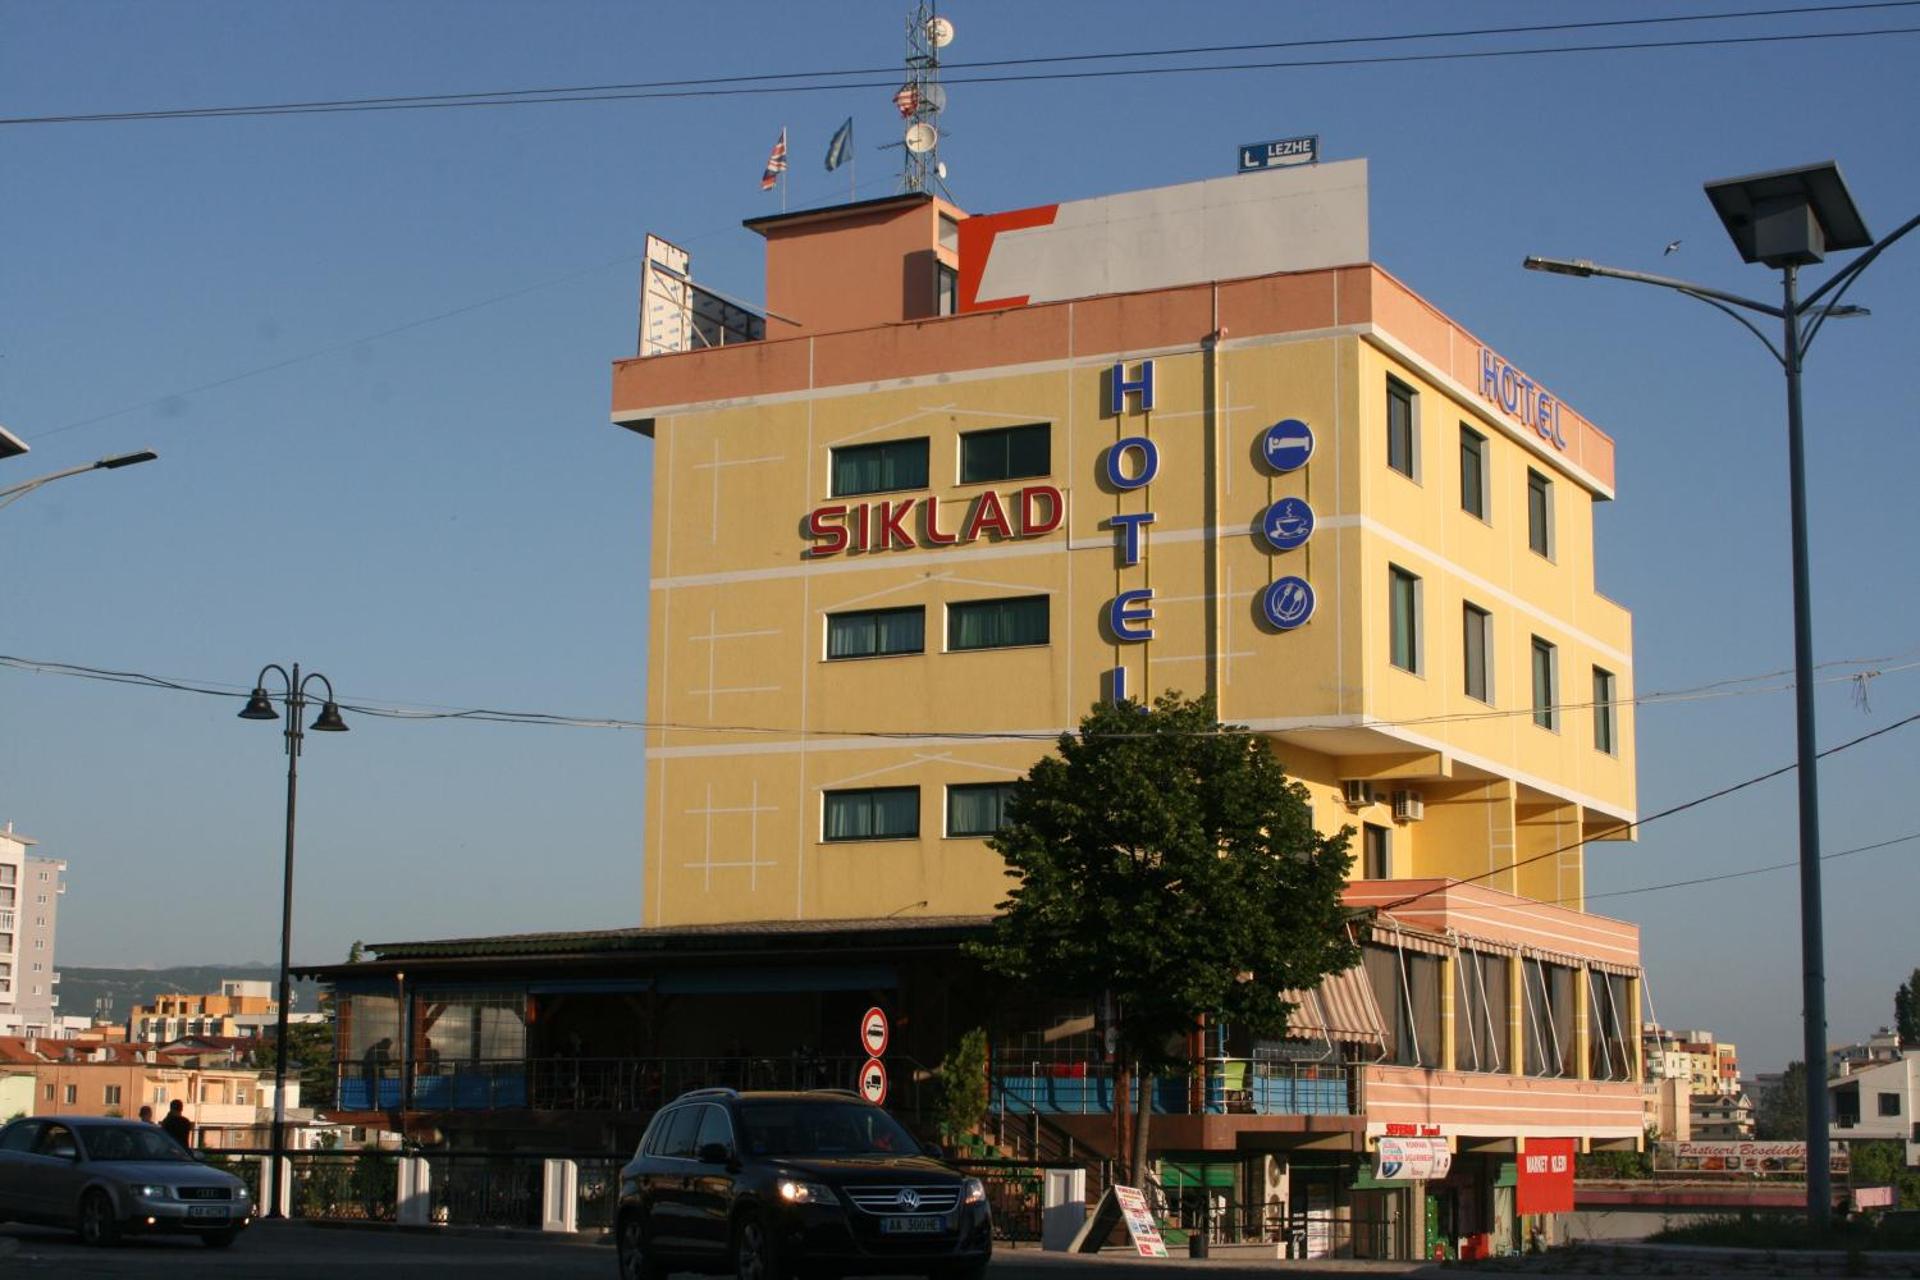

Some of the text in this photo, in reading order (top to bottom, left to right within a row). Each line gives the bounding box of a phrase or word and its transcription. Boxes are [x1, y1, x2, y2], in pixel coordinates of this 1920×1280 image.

[1268, 139, 1311, 157] LEZHE
[1479, 347, 1567, 450] HOTEL
[809, 485, 1066, 556] SIKLAD
[1107, 359, 1160, 711] HOTEL
[1526, 1155, 1548, 1173] MARKET
